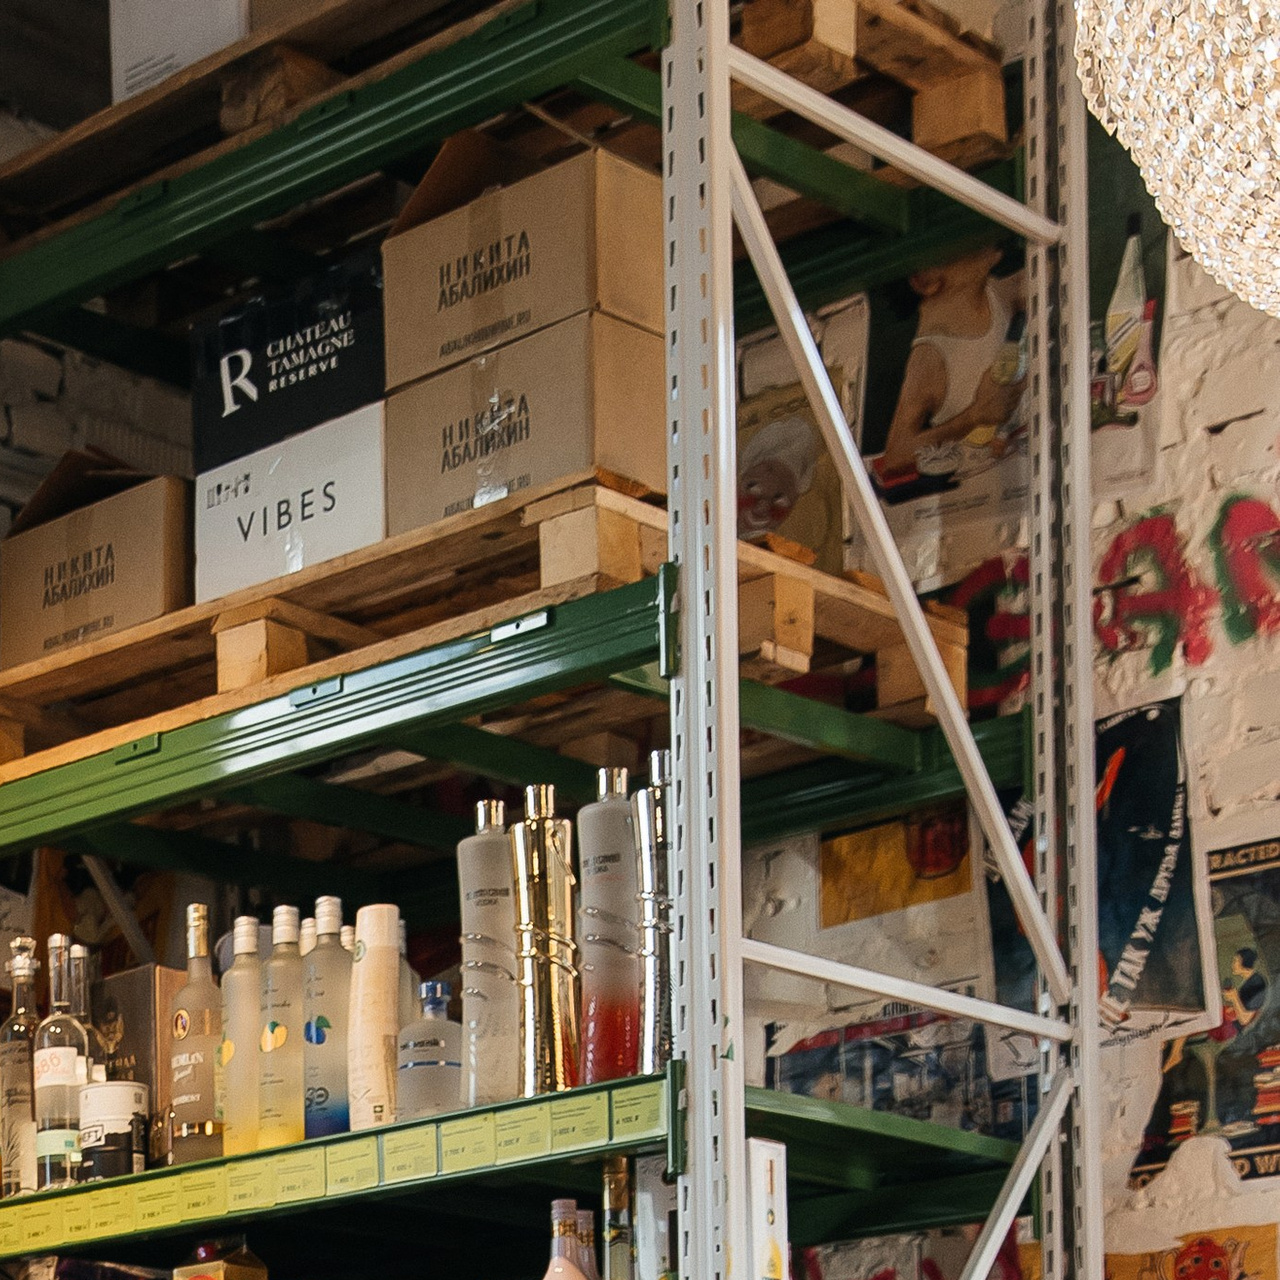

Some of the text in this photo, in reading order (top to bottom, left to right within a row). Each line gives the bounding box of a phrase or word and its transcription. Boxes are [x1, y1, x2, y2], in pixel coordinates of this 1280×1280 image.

[437, 252, 531, 313] АБАЛИХИН
[440, 231, 530, 288] НИКИТА
[266, 311, 352, 358] CHATEAU
[268, 329, 356, 377] TAMAGNE
[221, 348, 259, 418] R
[269, 354, 339, 393] RESERVE
[237, 480, 336, 541] VIBES
[42, 563, 115, 609] АБАЛИХИН
[44, 542, 115, 587] НИКИТА
